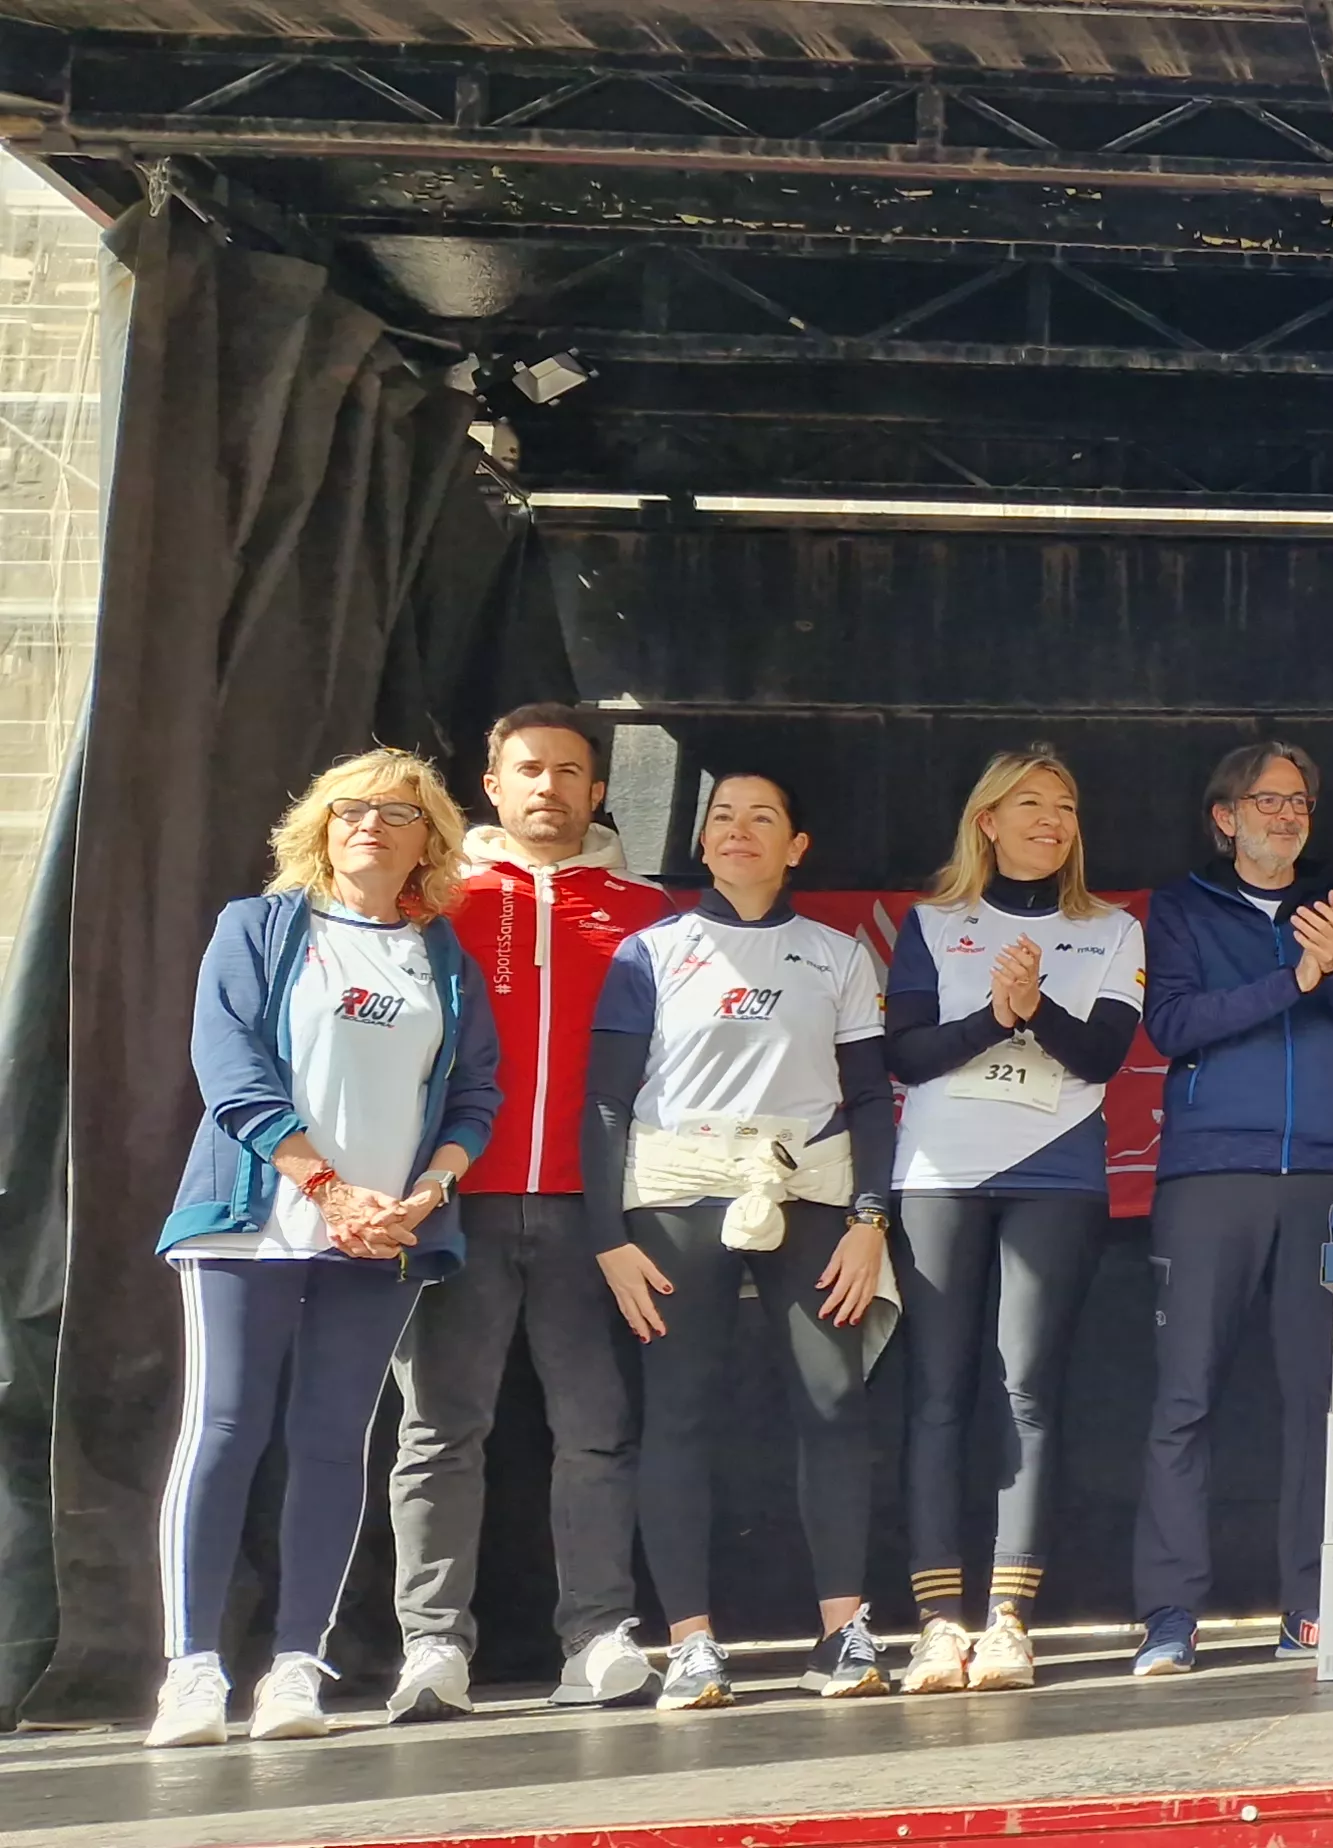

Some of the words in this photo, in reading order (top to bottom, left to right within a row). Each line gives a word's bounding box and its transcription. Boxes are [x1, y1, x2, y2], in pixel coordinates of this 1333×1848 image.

[493, 878, 516, 995] #SportsSantander
[578, 920, 626, 933] Santander
[984, 1063, 1027, 1085] 321
